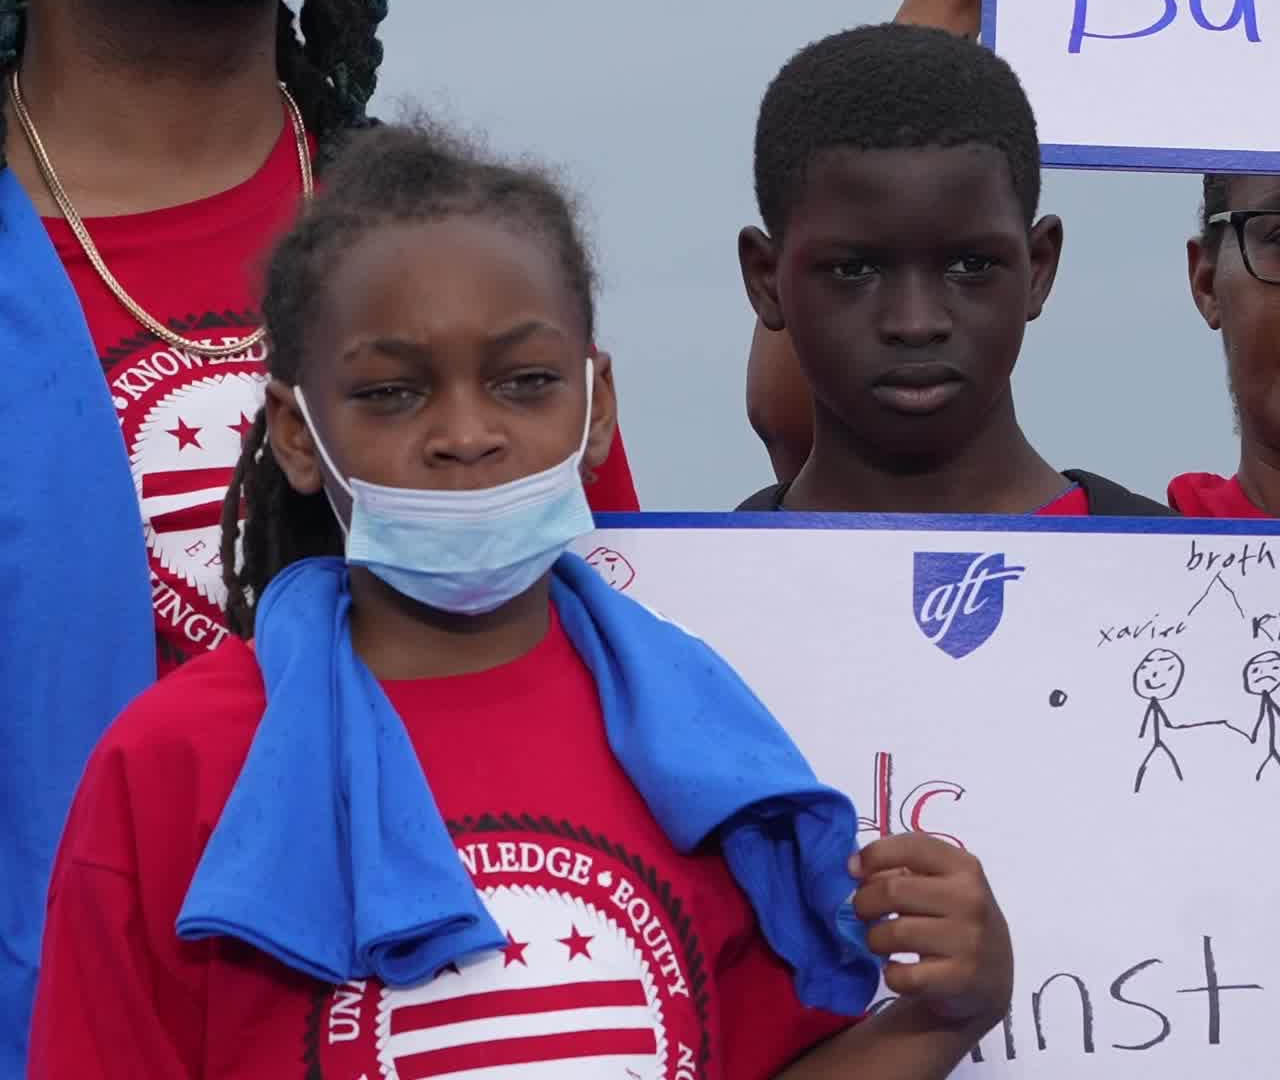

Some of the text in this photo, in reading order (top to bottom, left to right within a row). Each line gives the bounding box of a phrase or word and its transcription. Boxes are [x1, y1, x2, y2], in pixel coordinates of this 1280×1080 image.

[112, 336, 269, 401] KNOWLED
[921, 552, 1025, 644] aft
[609, 877, 690, 999] EQUITY
